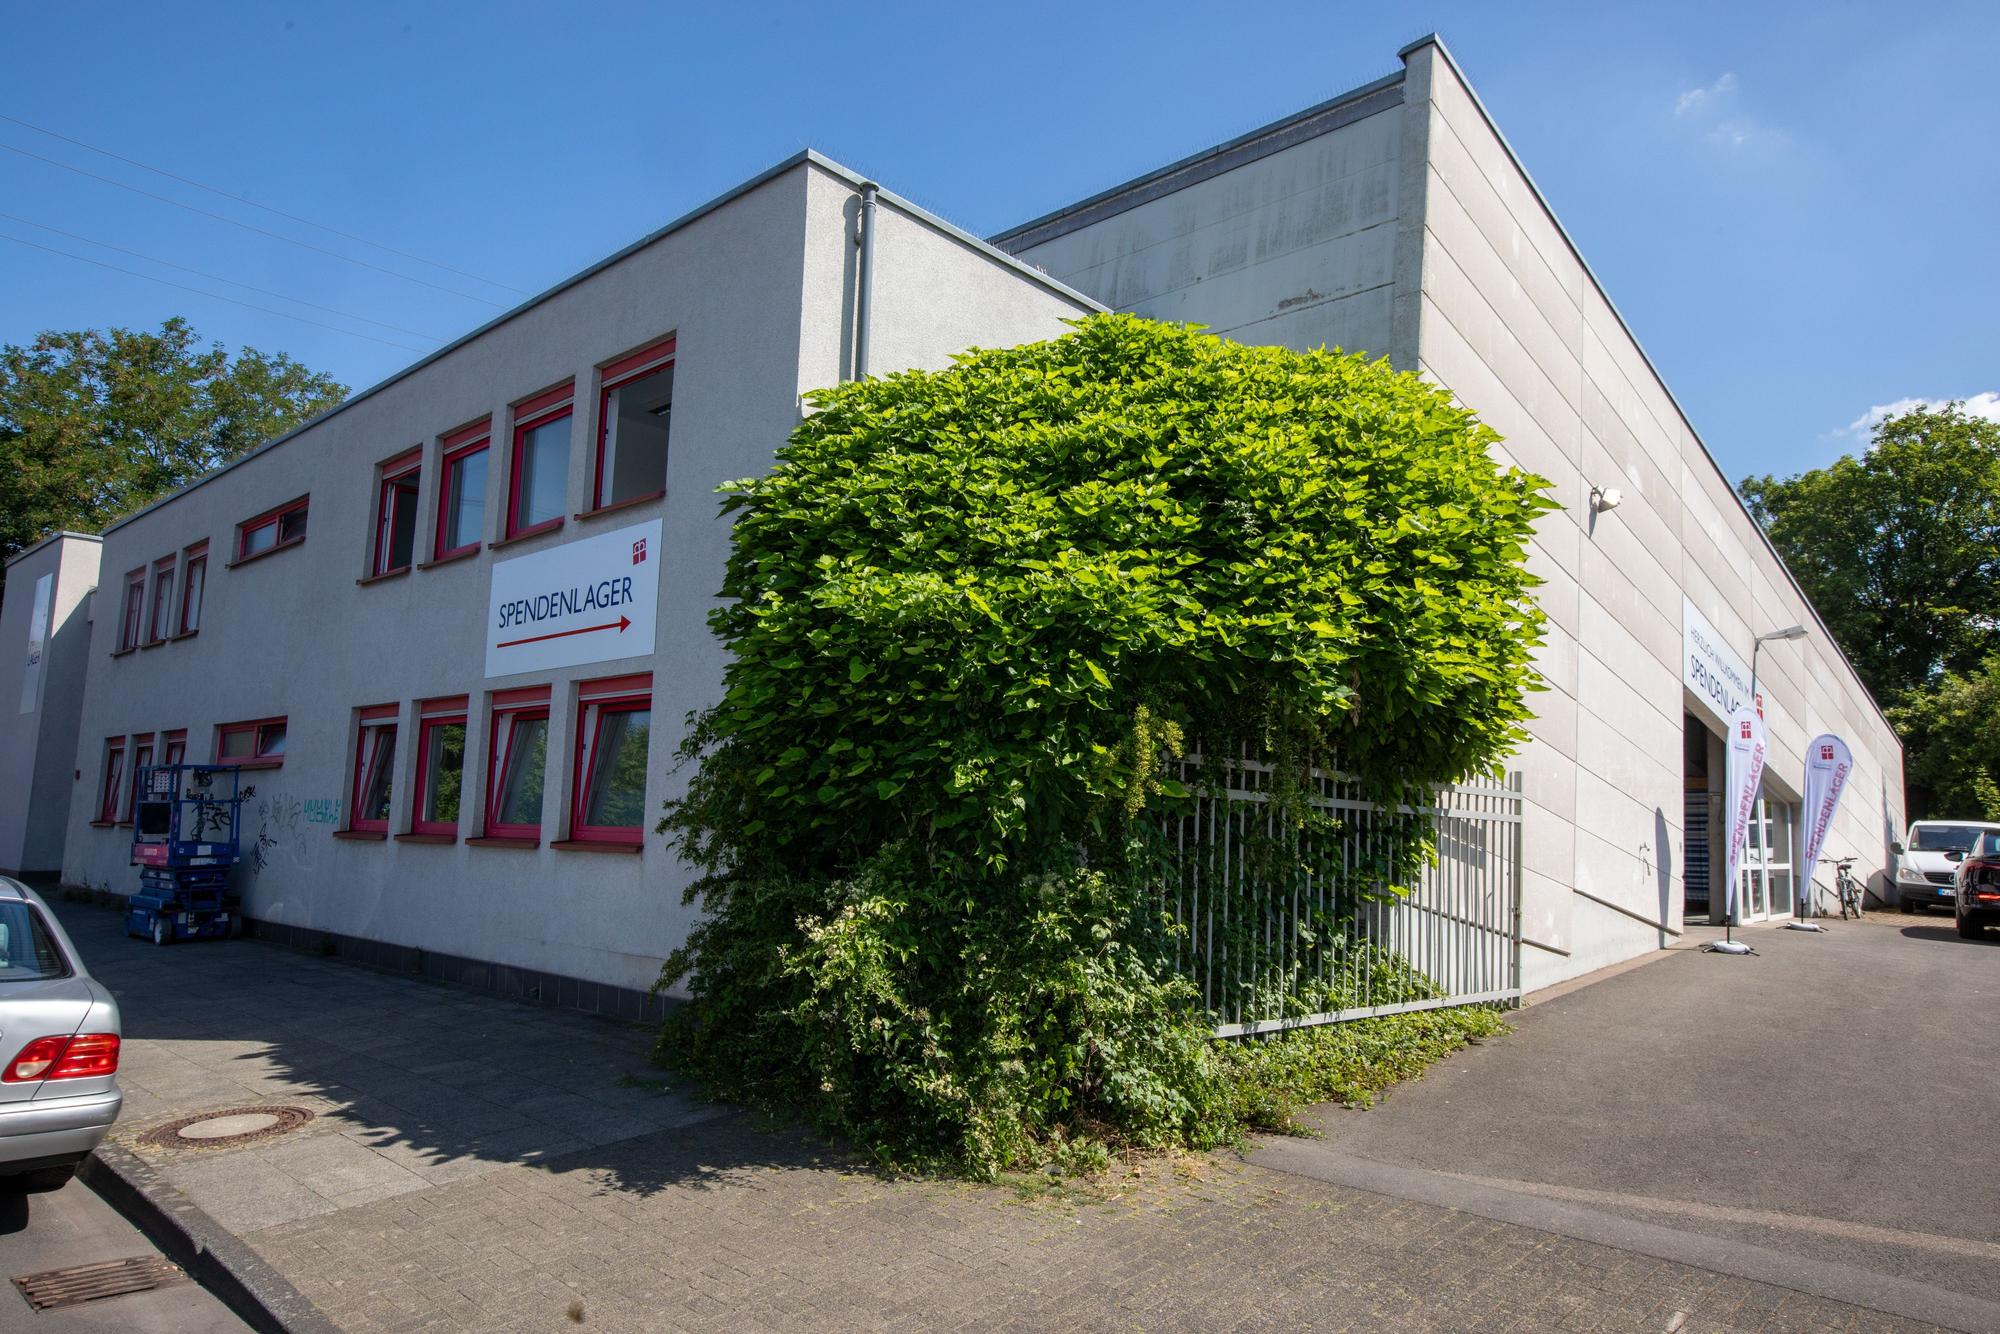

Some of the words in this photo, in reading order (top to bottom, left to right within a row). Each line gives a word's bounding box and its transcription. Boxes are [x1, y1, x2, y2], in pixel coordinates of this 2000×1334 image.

[498, 576, 634, 629] SPENDENLAGER
[1690, 624, 1714, 660] HERZLICH
[1714, 652, 1743, 693] WILLKOMMEN
[1690, 654, 1741, 716] SPENDENLA
